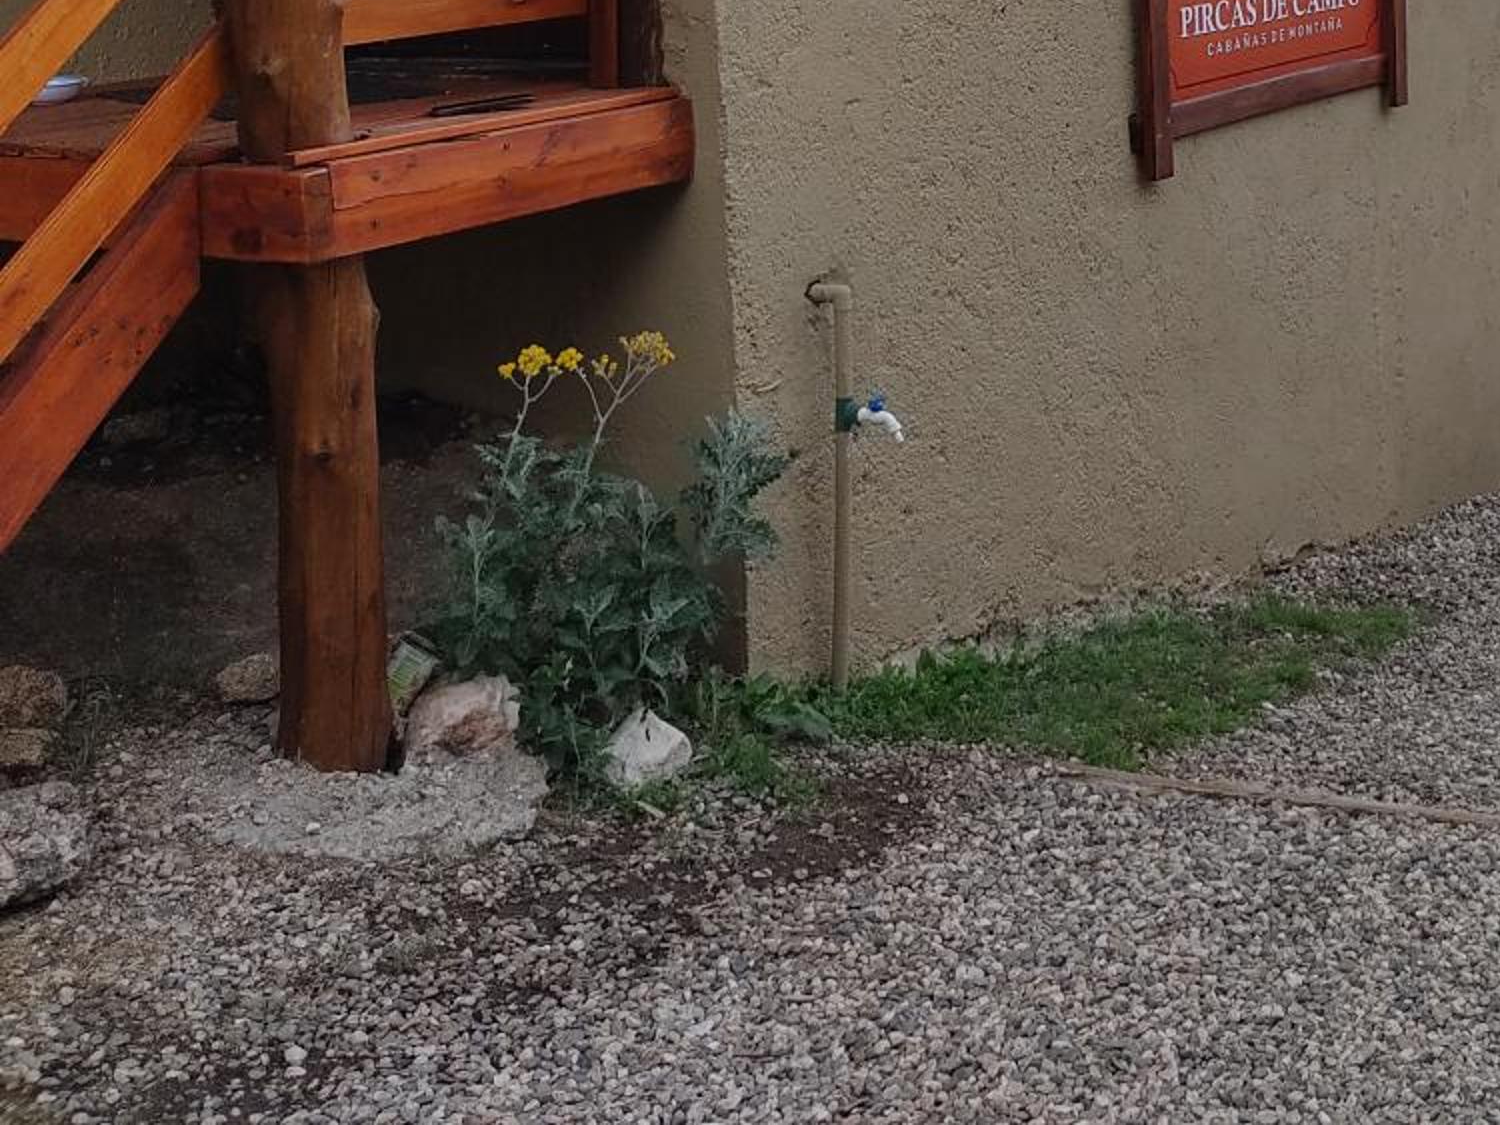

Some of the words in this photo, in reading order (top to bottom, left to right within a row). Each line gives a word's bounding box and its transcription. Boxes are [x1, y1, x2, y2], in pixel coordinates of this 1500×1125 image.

[1207, 32, 1267, 56] CABAÑAS
[1271, 29, 1286, 43] DE
[1288, 17, 1343, 39] MONTAÑA
